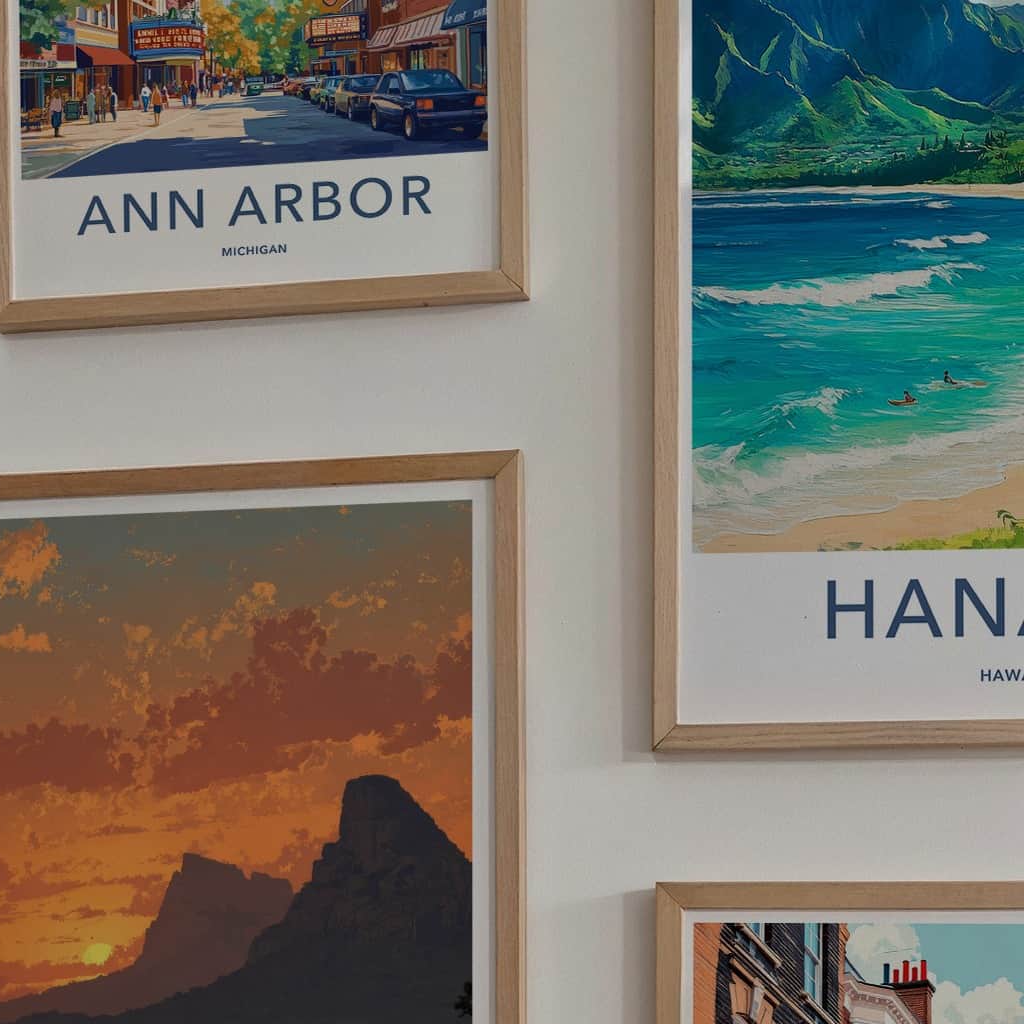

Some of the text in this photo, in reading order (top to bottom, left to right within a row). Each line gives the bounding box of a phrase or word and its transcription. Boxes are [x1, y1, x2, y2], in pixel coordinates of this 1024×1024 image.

[77, 175, 432, 236] ANN ARBOR
[221, 244, 288, 257] MICHIGAN
[826, 577, 1024, 639] HAN
[980, 669, 1024, 682] HAW
